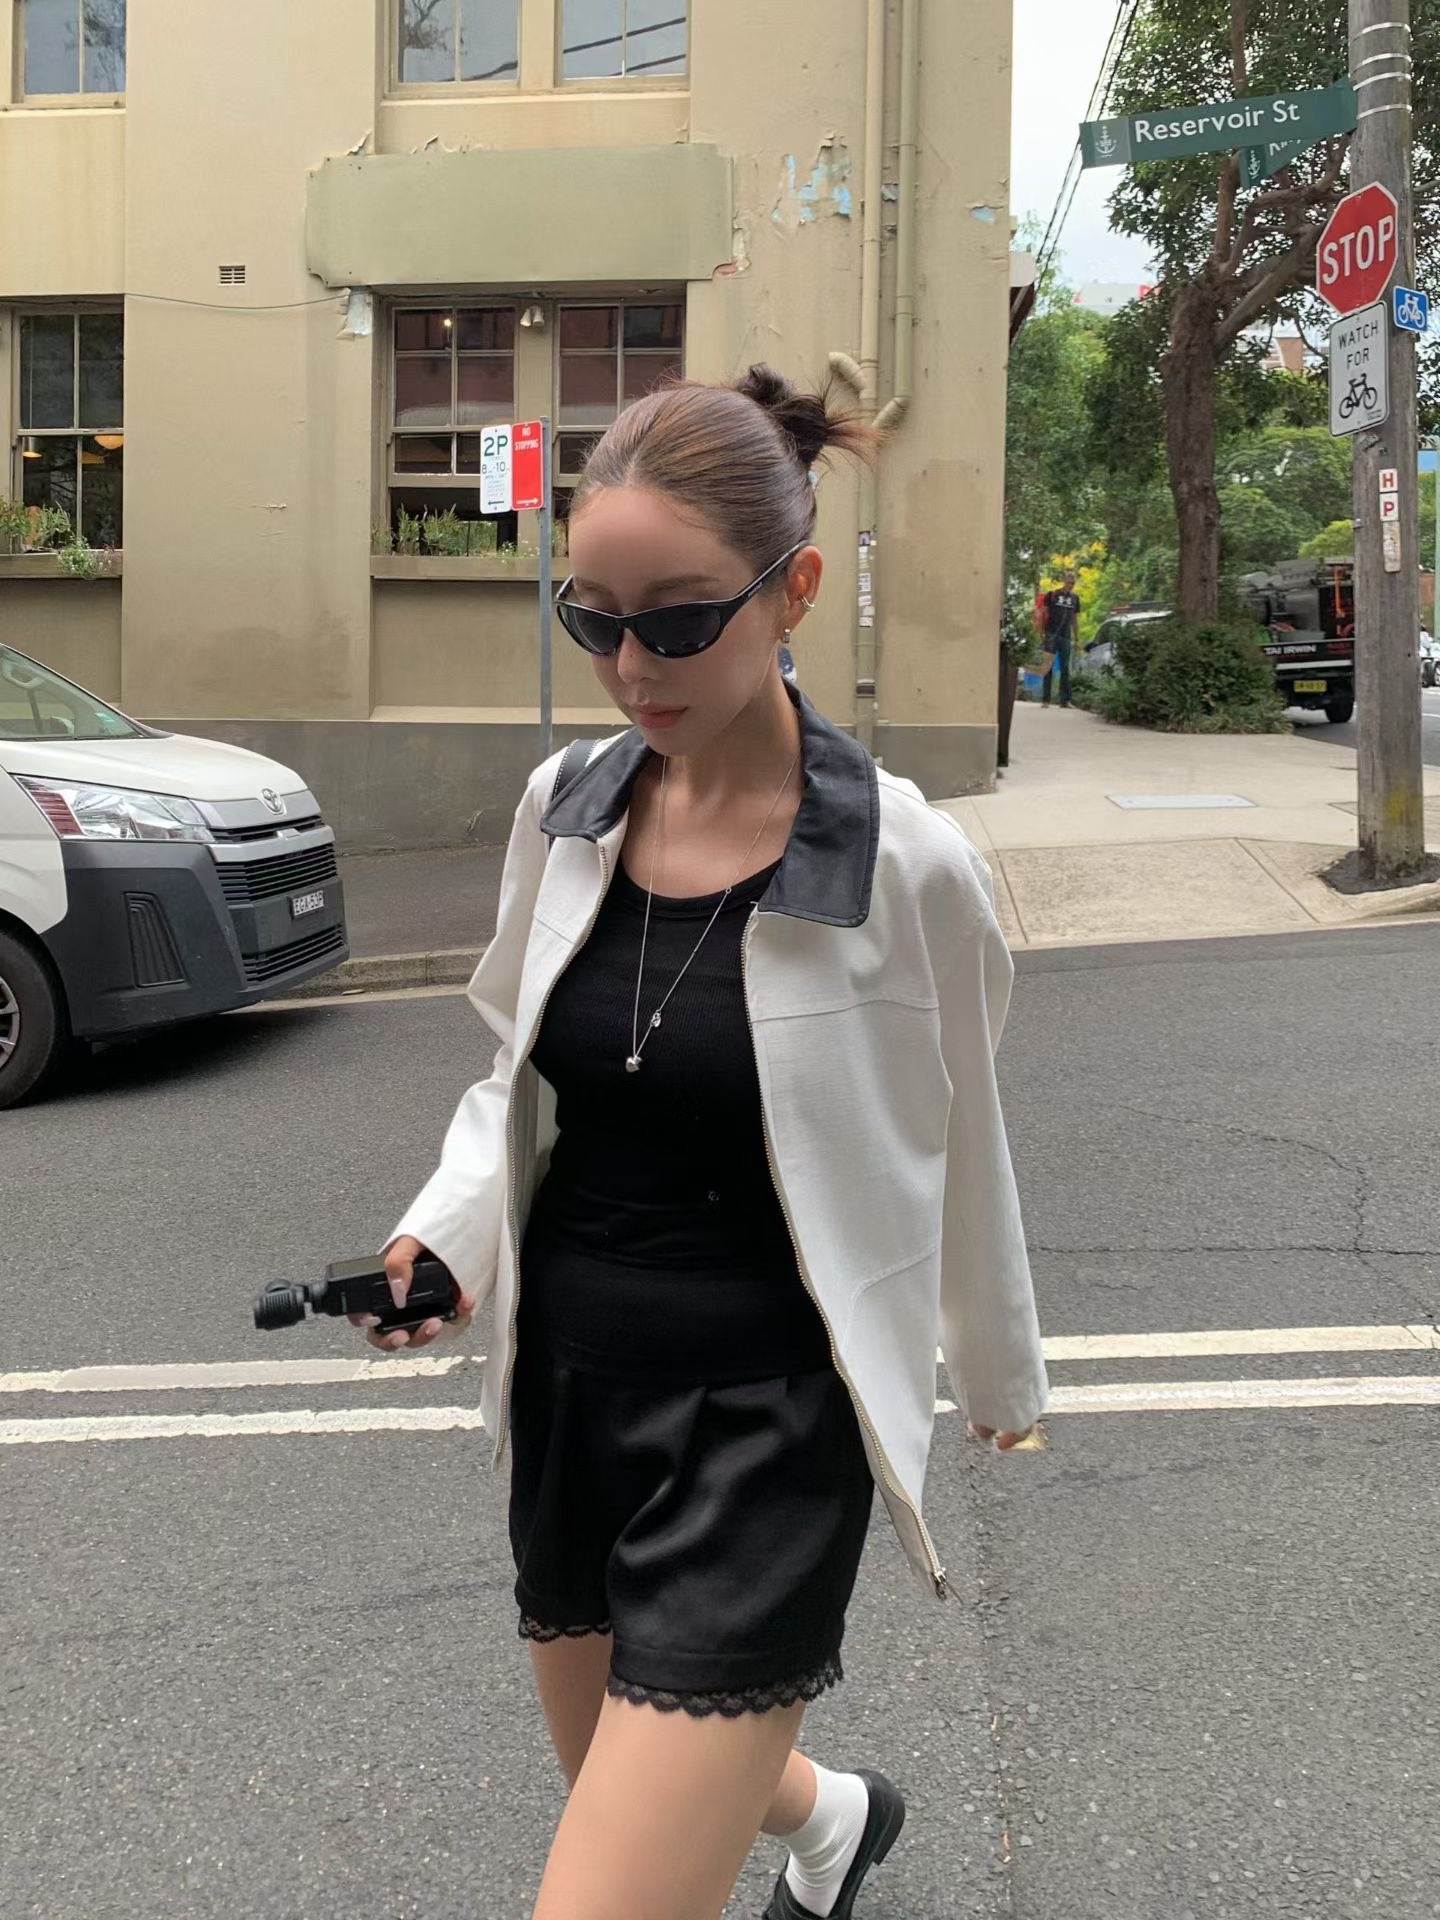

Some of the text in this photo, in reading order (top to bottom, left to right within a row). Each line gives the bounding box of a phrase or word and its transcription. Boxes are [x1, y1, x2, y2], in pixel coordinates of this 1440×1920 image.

[1134, 100, 1300, 143] Reservoir St
[1322, 215, 1394, 285] STOP
[1338, 320, 1379, 349] WATCH
[1346, 347, 1370, 370] FOR
[484, 435, 508, 456] 2P
[1382, 472, 1395, 488] H
[1383, 501, 1396, 517] P
